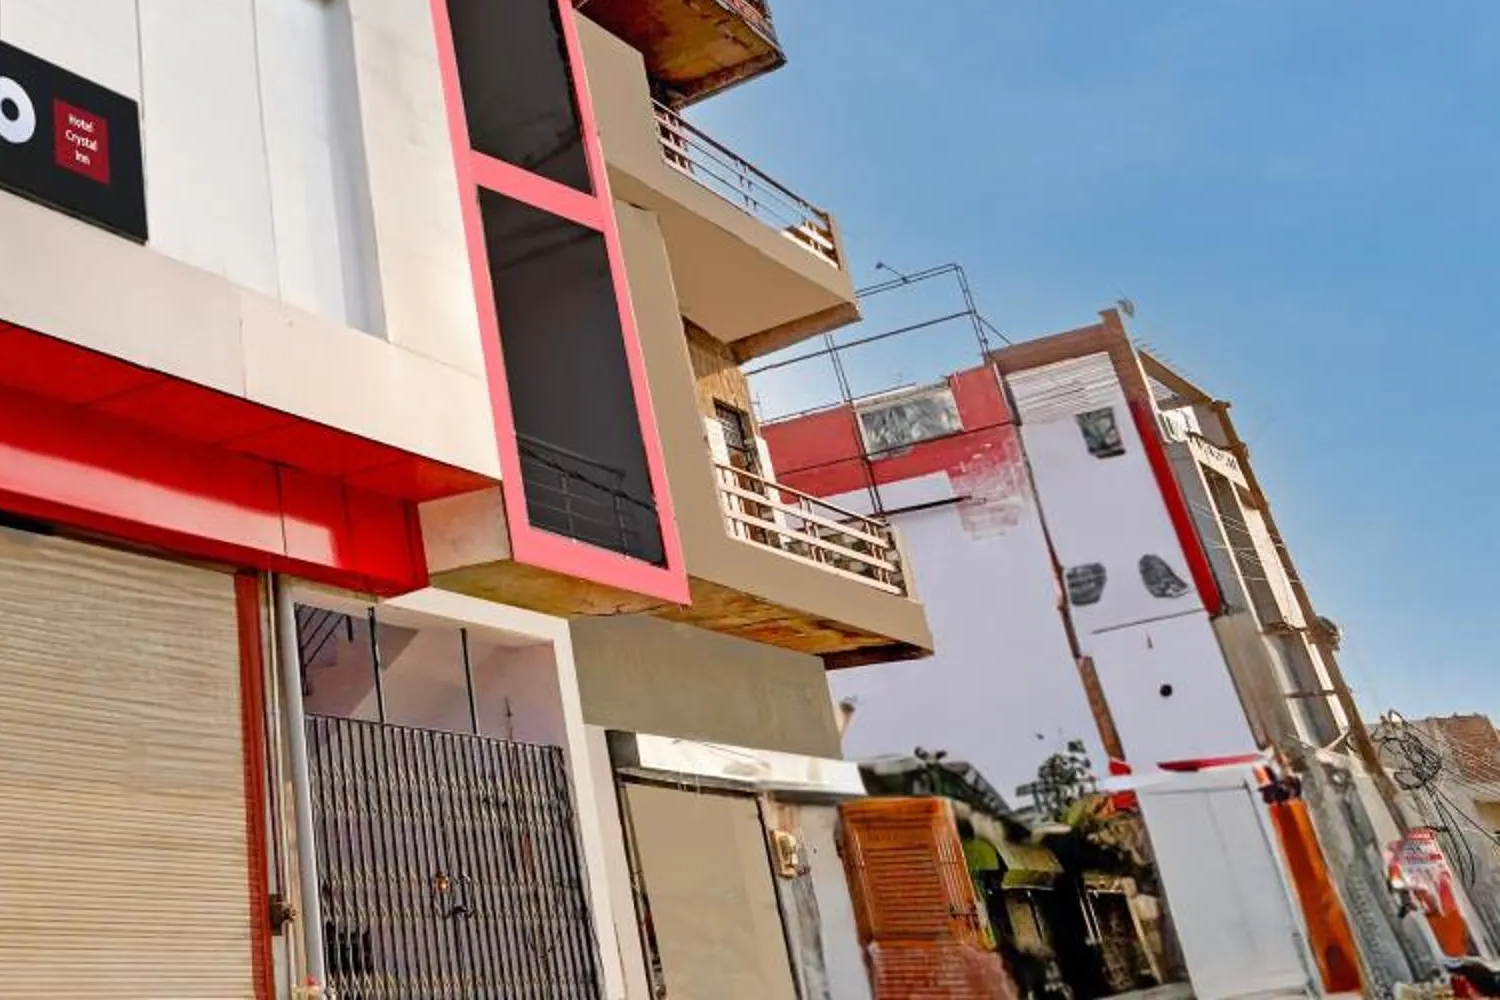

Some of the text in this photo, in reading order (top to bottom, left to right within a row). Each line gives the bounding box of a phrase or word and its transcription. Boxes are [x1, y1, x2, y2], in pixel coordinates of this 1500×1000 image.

[68, 113, 94, 133] Hotel
[65, 129, 98, 152] Crystal
[75, 149, 91, 166] Inn
